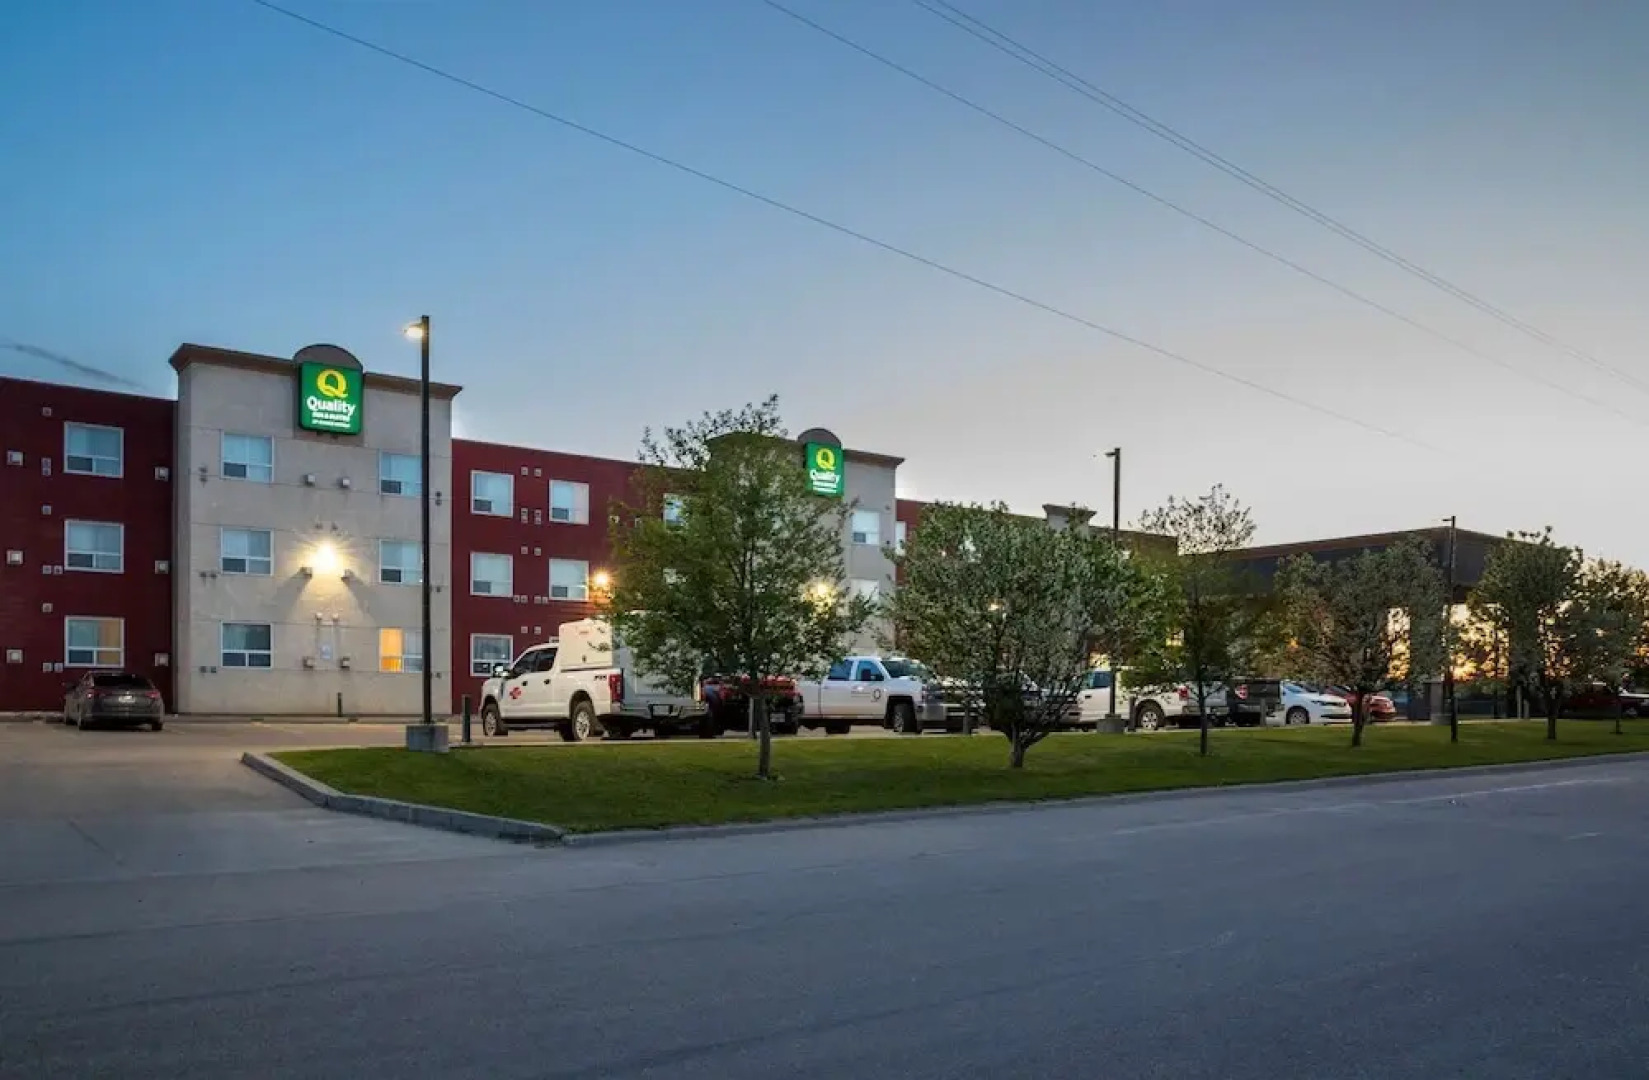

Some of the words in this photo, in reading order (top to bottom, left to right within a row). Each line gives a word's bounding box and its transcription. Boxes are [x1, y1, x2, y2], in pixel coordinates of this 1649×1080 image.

[317, 369, 349, 398] Q
[306, 395, 356, 416] Quality
[816, 448, 837, 470] Q
